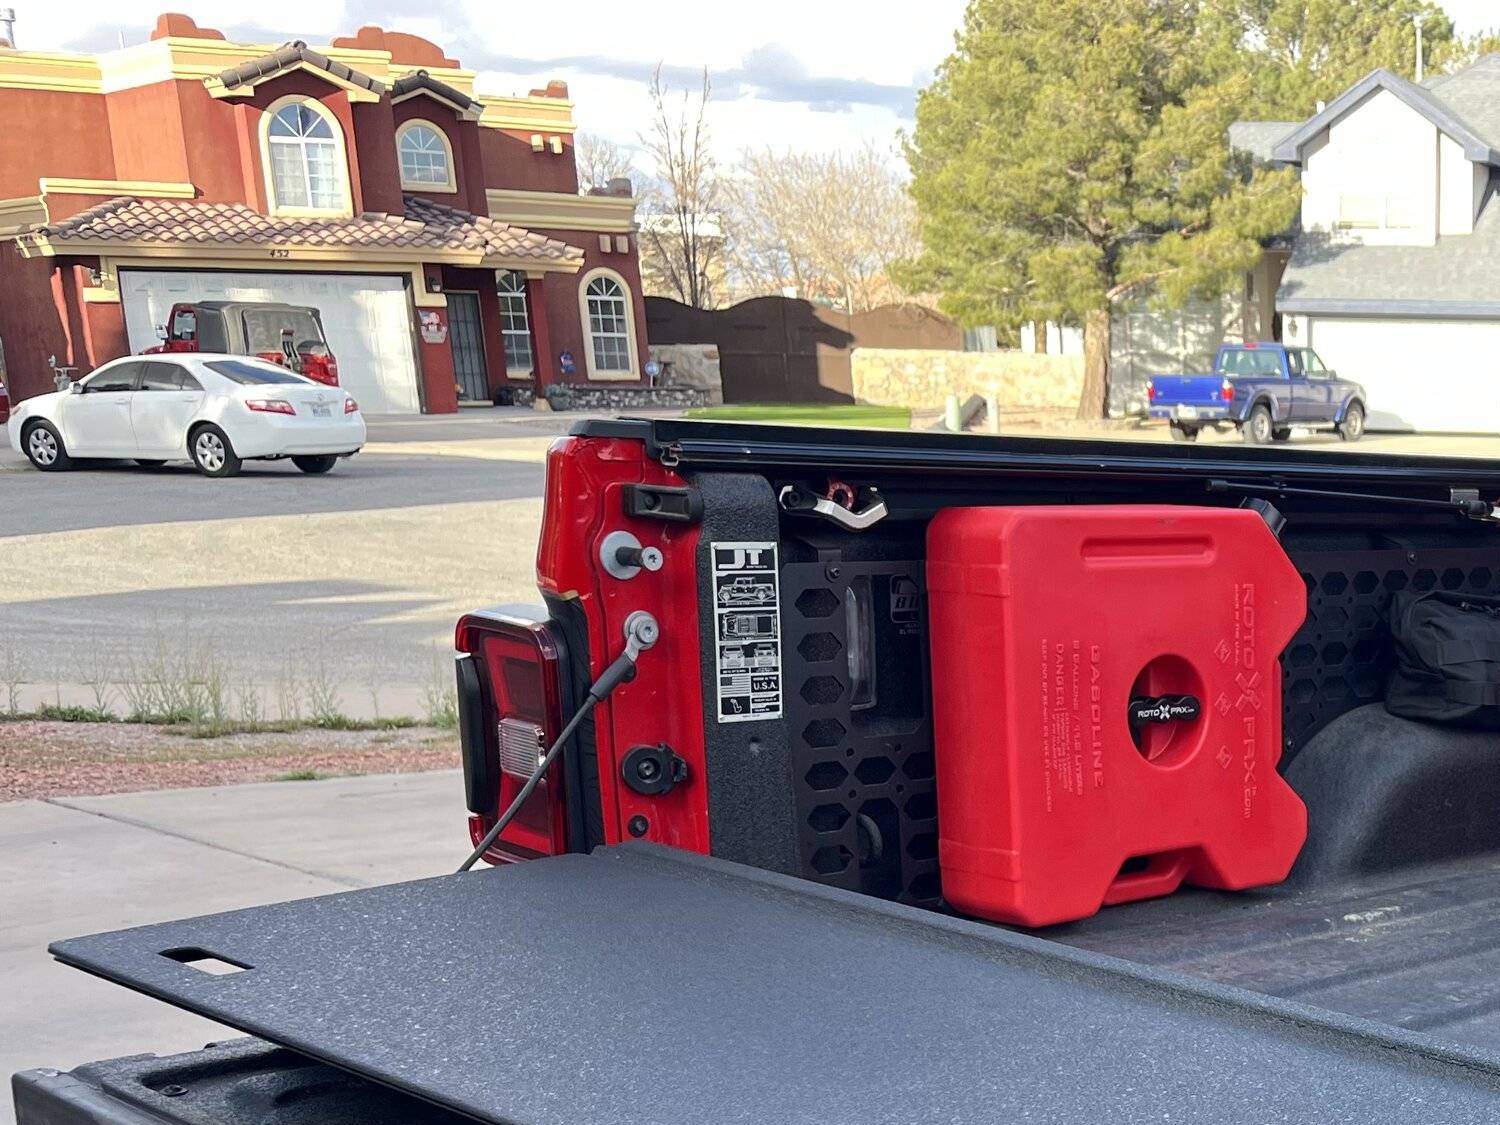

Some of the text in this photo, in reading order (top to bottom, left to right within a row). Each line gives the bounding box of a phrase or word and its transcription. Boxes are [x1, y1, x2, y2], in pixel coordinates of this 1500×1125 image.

[718, 549, 763, 570] JT
[1055, 643, 1064, 706] DANGER
[752, 681, 779, 690] U.S.A.
